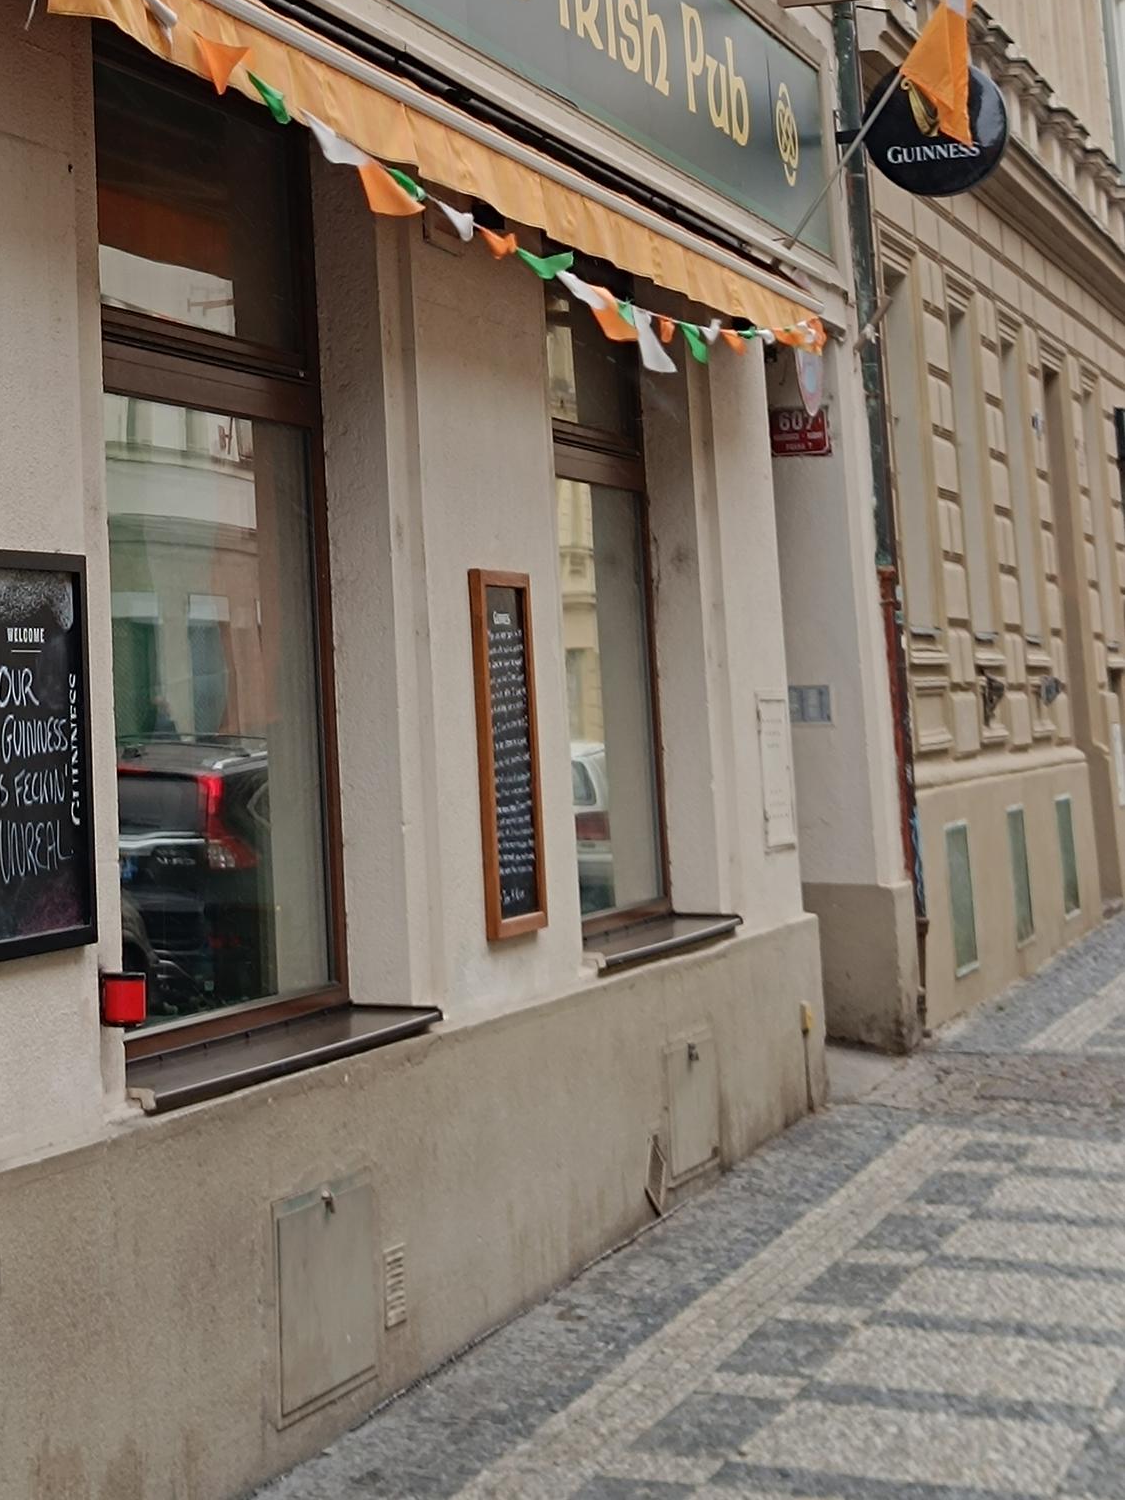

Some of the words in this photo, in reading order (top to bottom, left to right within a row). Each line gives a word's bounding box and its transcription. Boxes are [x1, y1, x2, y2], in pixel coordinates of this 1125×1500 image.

[680, 1, 751, 147] Pub
[886, 141, 981, 164] GUINNESS
[6, 627, 45, 643] WELCOME
[1, 714, 68, 764] GUINNESS
[15, 764, 68, 807] FECKIN'
